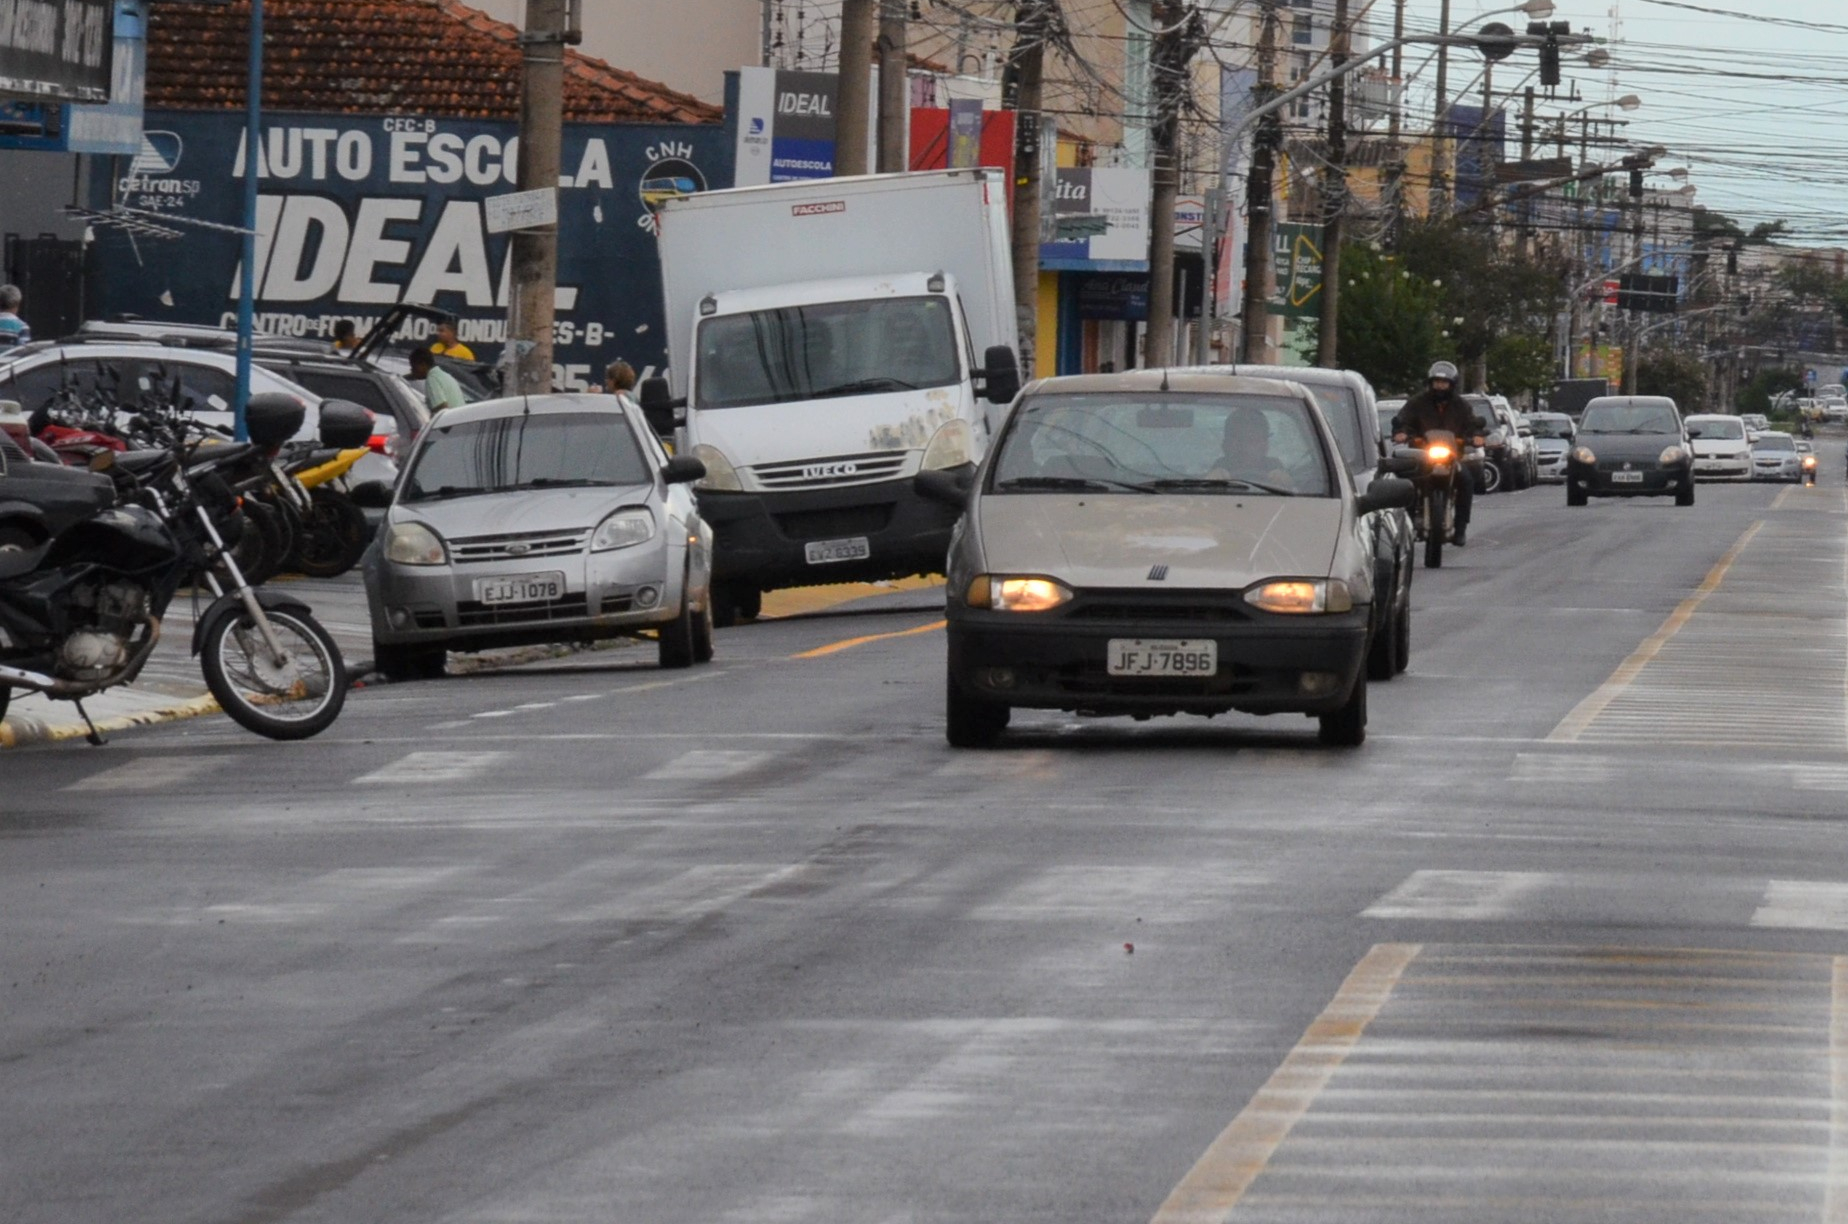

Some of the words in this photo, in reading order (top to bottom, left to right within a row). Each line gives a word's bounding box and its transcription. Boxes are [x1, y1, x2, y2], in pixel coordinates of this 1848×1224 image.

[778, 92, 831, 116] IDEAL
[383, 117, 436, 133] CFC-B
[232, 126, 372, 180] AUTO
[390, 132, 613, 189] ESCA
[645, 141, 693, 162] CNH
[773, 159, 832, 171] AUTOESCOLA
[793, 202, 845, 215] FACCHINI
[219, 311, 306, 339] CNTRO
[802, 463, 857, 479] IVECO
[484, 582, 557, 601] EJJ-1078
[1113, 652, 1211, 671] JFJ-7896
